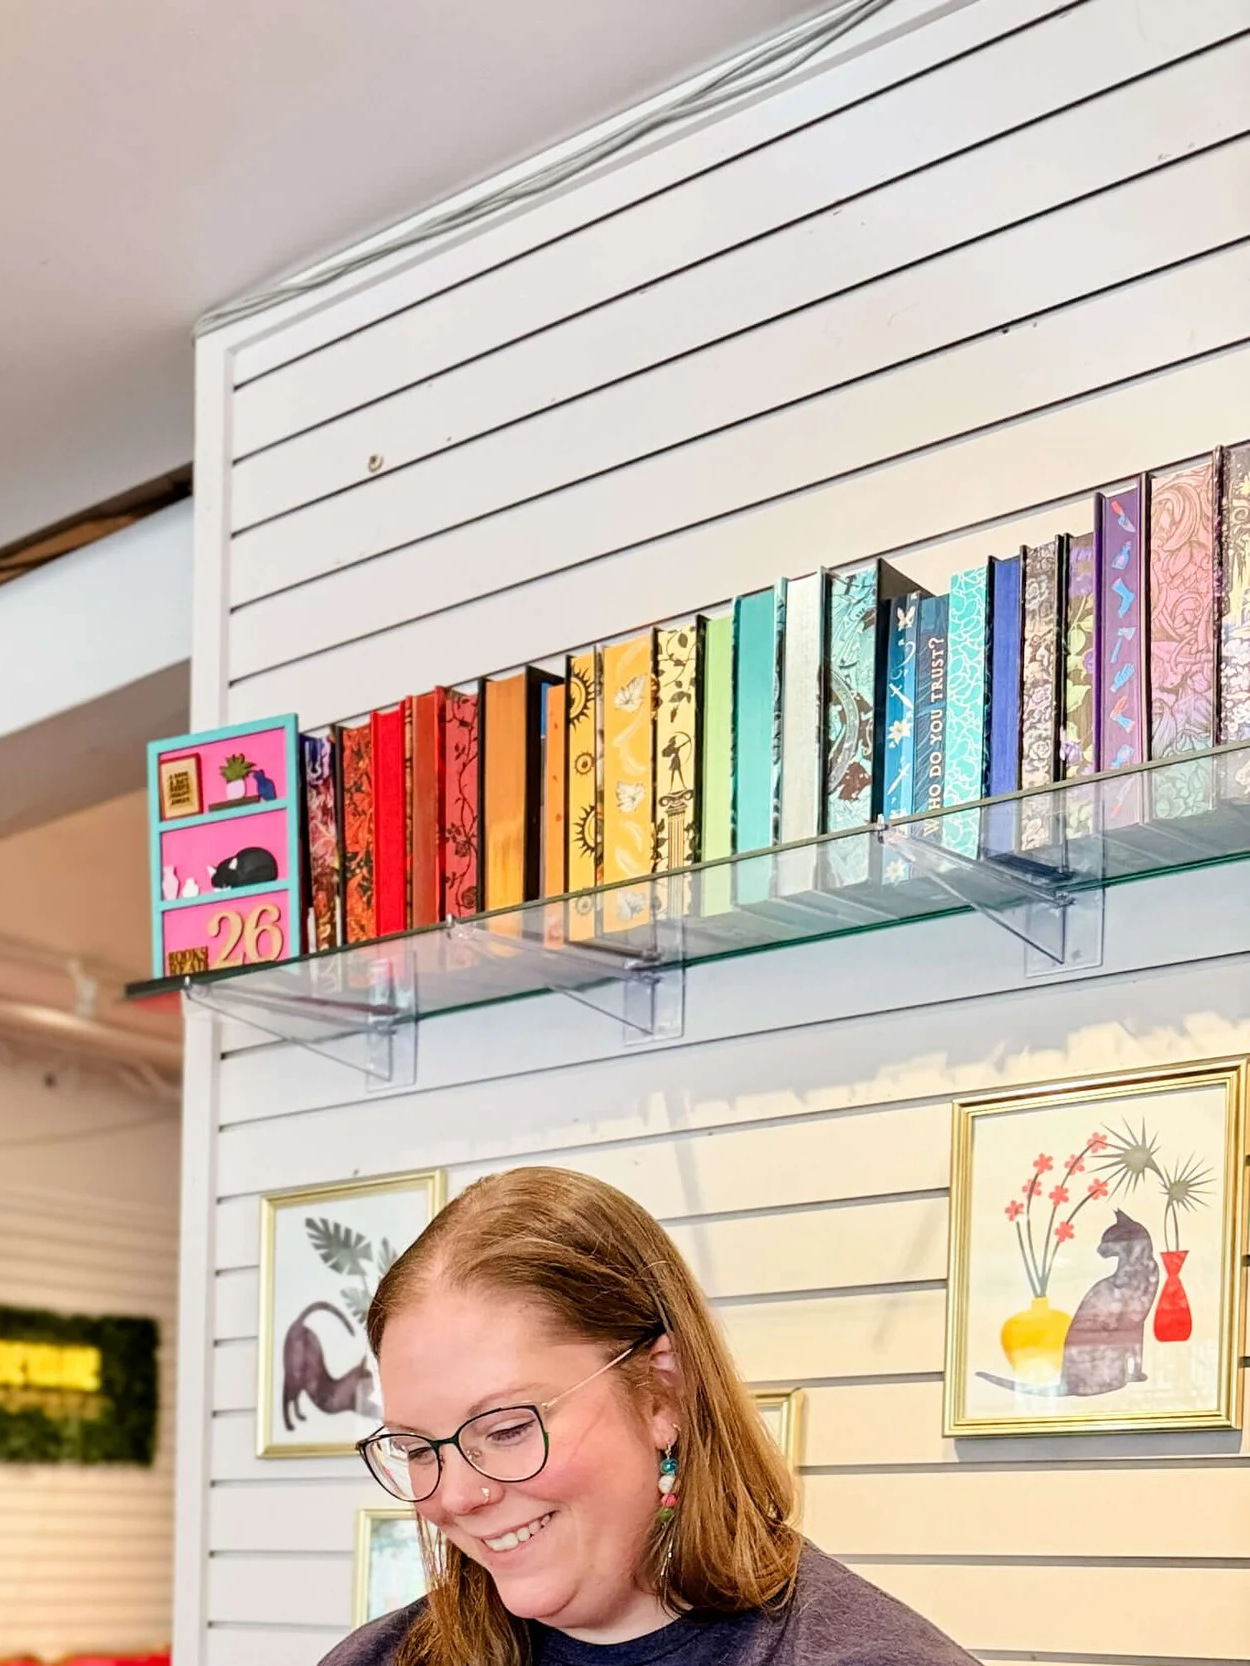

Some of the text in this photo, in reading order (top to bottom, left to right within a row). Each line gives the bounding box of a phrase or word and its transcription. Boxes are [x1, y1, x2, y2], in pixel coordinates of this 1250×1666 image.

[928, 636, 945, 702] TRUST?
[929, 709, 943, 743] YOU
[929, 751, 942, 777] DO
[208, 903, 284, 969] 26
